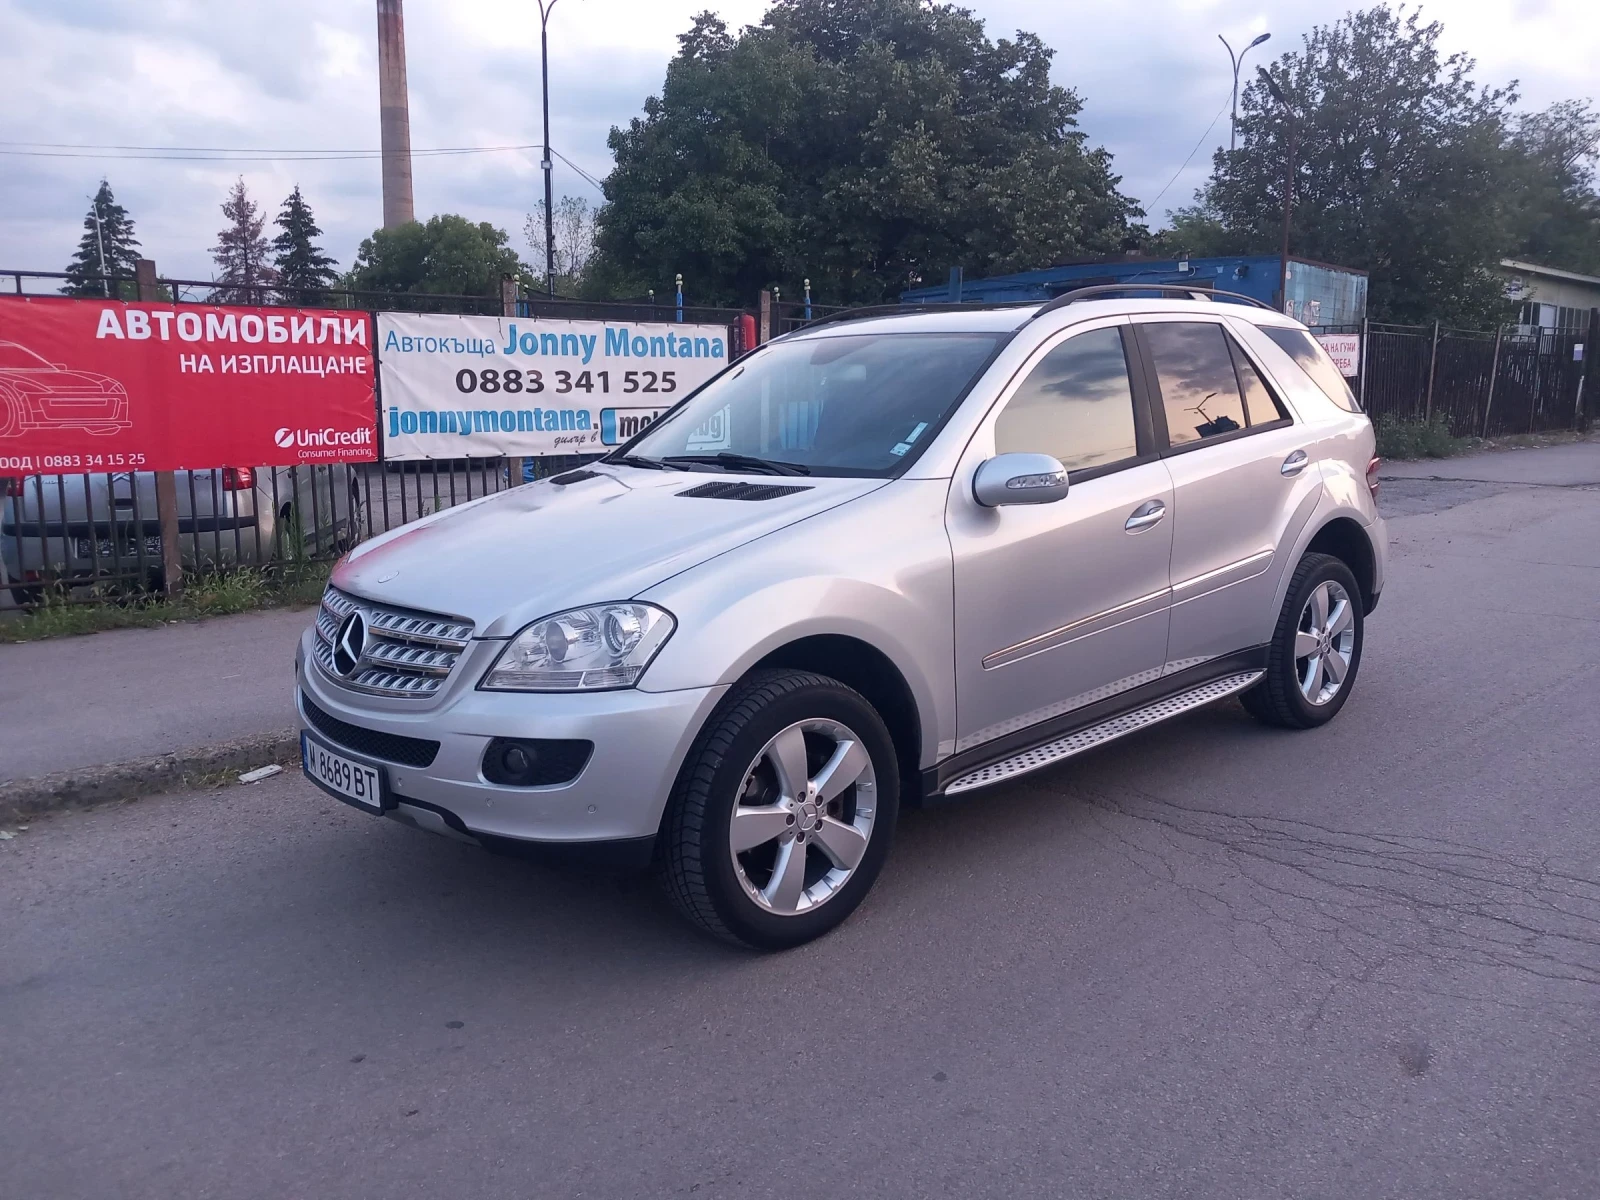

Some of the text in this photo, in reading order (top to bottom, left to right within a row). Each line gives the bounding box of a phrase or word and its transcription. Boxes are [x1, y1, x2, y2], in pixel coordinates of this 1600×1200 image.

[96, 308, 366, 345] АВТОМОБИЛИ
[385, 330, 496, 358] Автокъща
[503, 324, 724, 365] Jonny Montana
[1330, 343, 1339, 352] НА
[180, 353, 367, 378] НА ИЗПЛАЩАНЕ
[455, 368, 677, 393] 0883 341 525
[297, 428, 371, 446] UniCredit
[553, 435, 587, 448] дилър
[44, 455, 80, 467] 0883
[85, 454, 103, 466] 34
[107, 454, 124, 465] 15
[128, 453, 145, 465] 25
[298, 448, 372, 458] Consumer Financing
[320, 752, 351, 791] 8689
